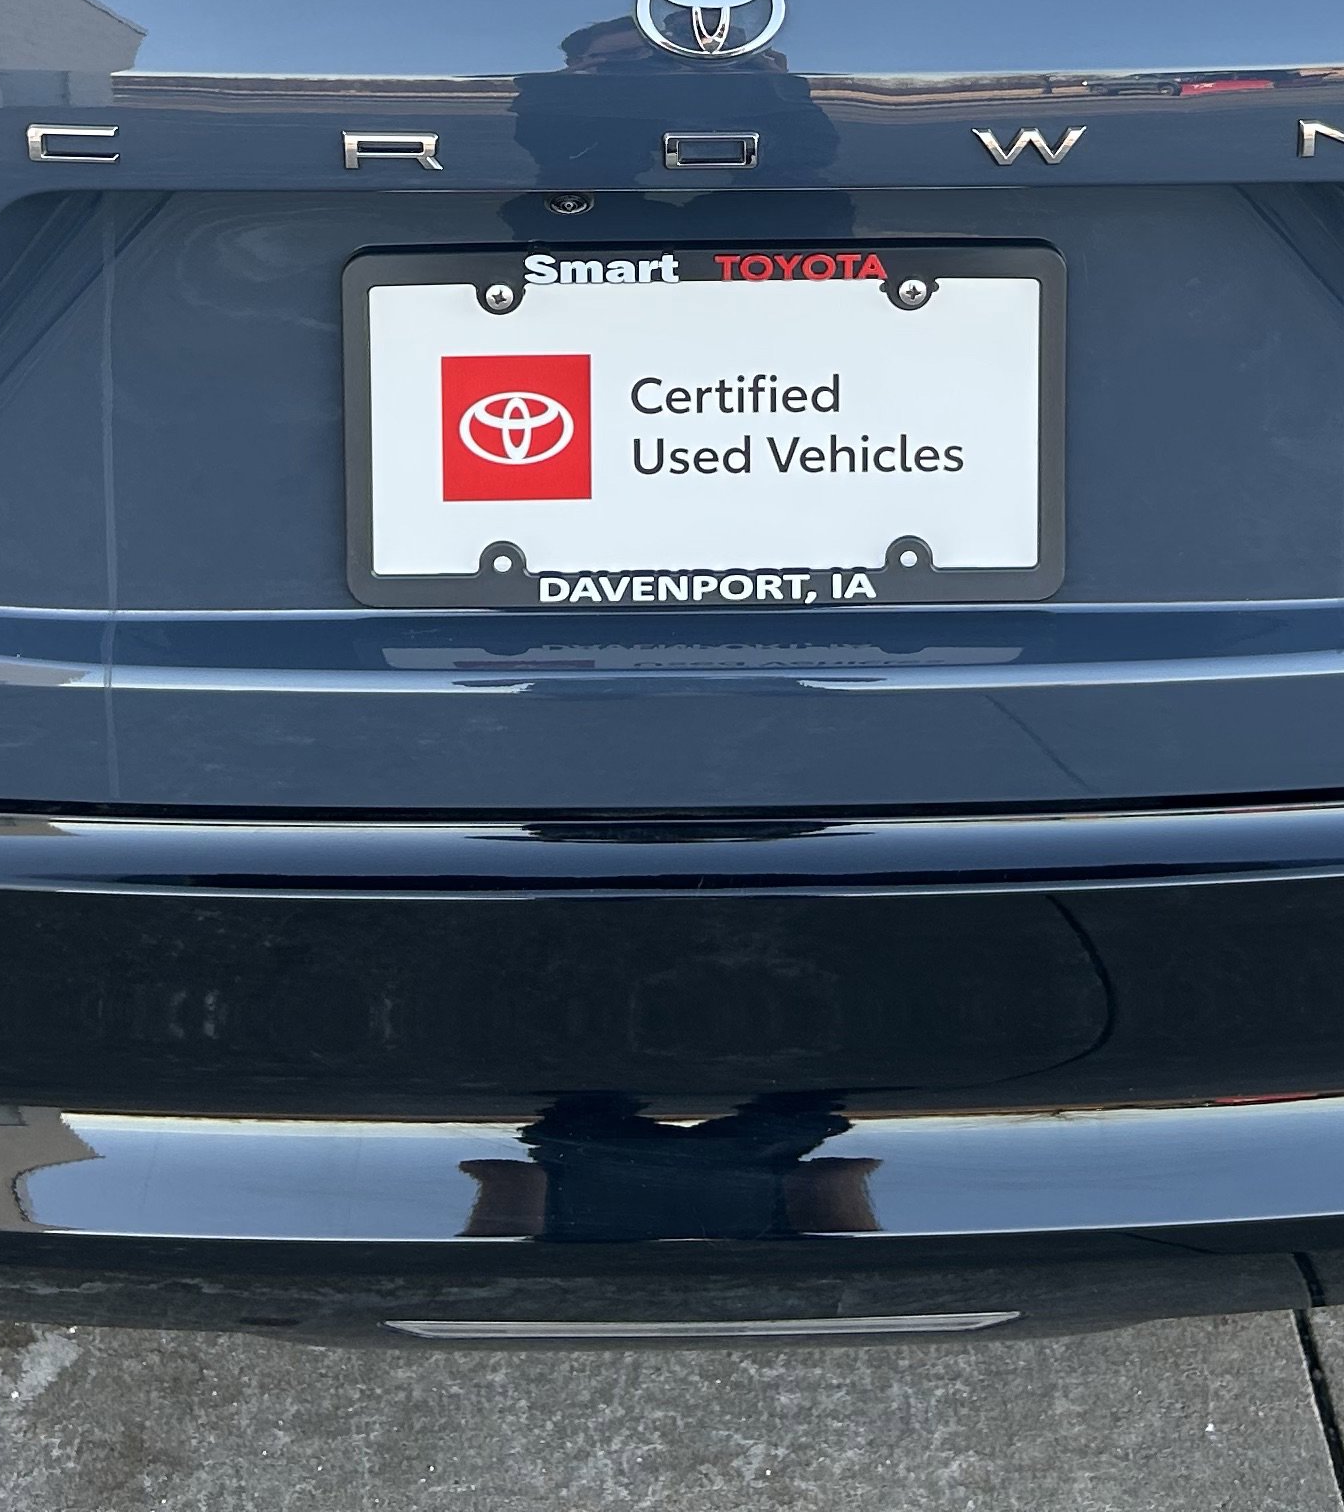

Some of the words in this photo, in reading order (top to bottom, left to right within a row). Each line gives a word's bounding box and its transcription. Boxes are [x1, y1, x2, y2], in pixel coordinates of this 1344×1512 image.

[523, 254, 680, 284] Smart
[714, 253, 889, 282] TOYOTA
[631, 374, 840, 414] Certified
[633, 435, 751, 475] Used
[766, 434, 964, 473] Vehicles
[539, 574, 818, 604] DAVENPORT,
[831, 573, 877, 600] IA
